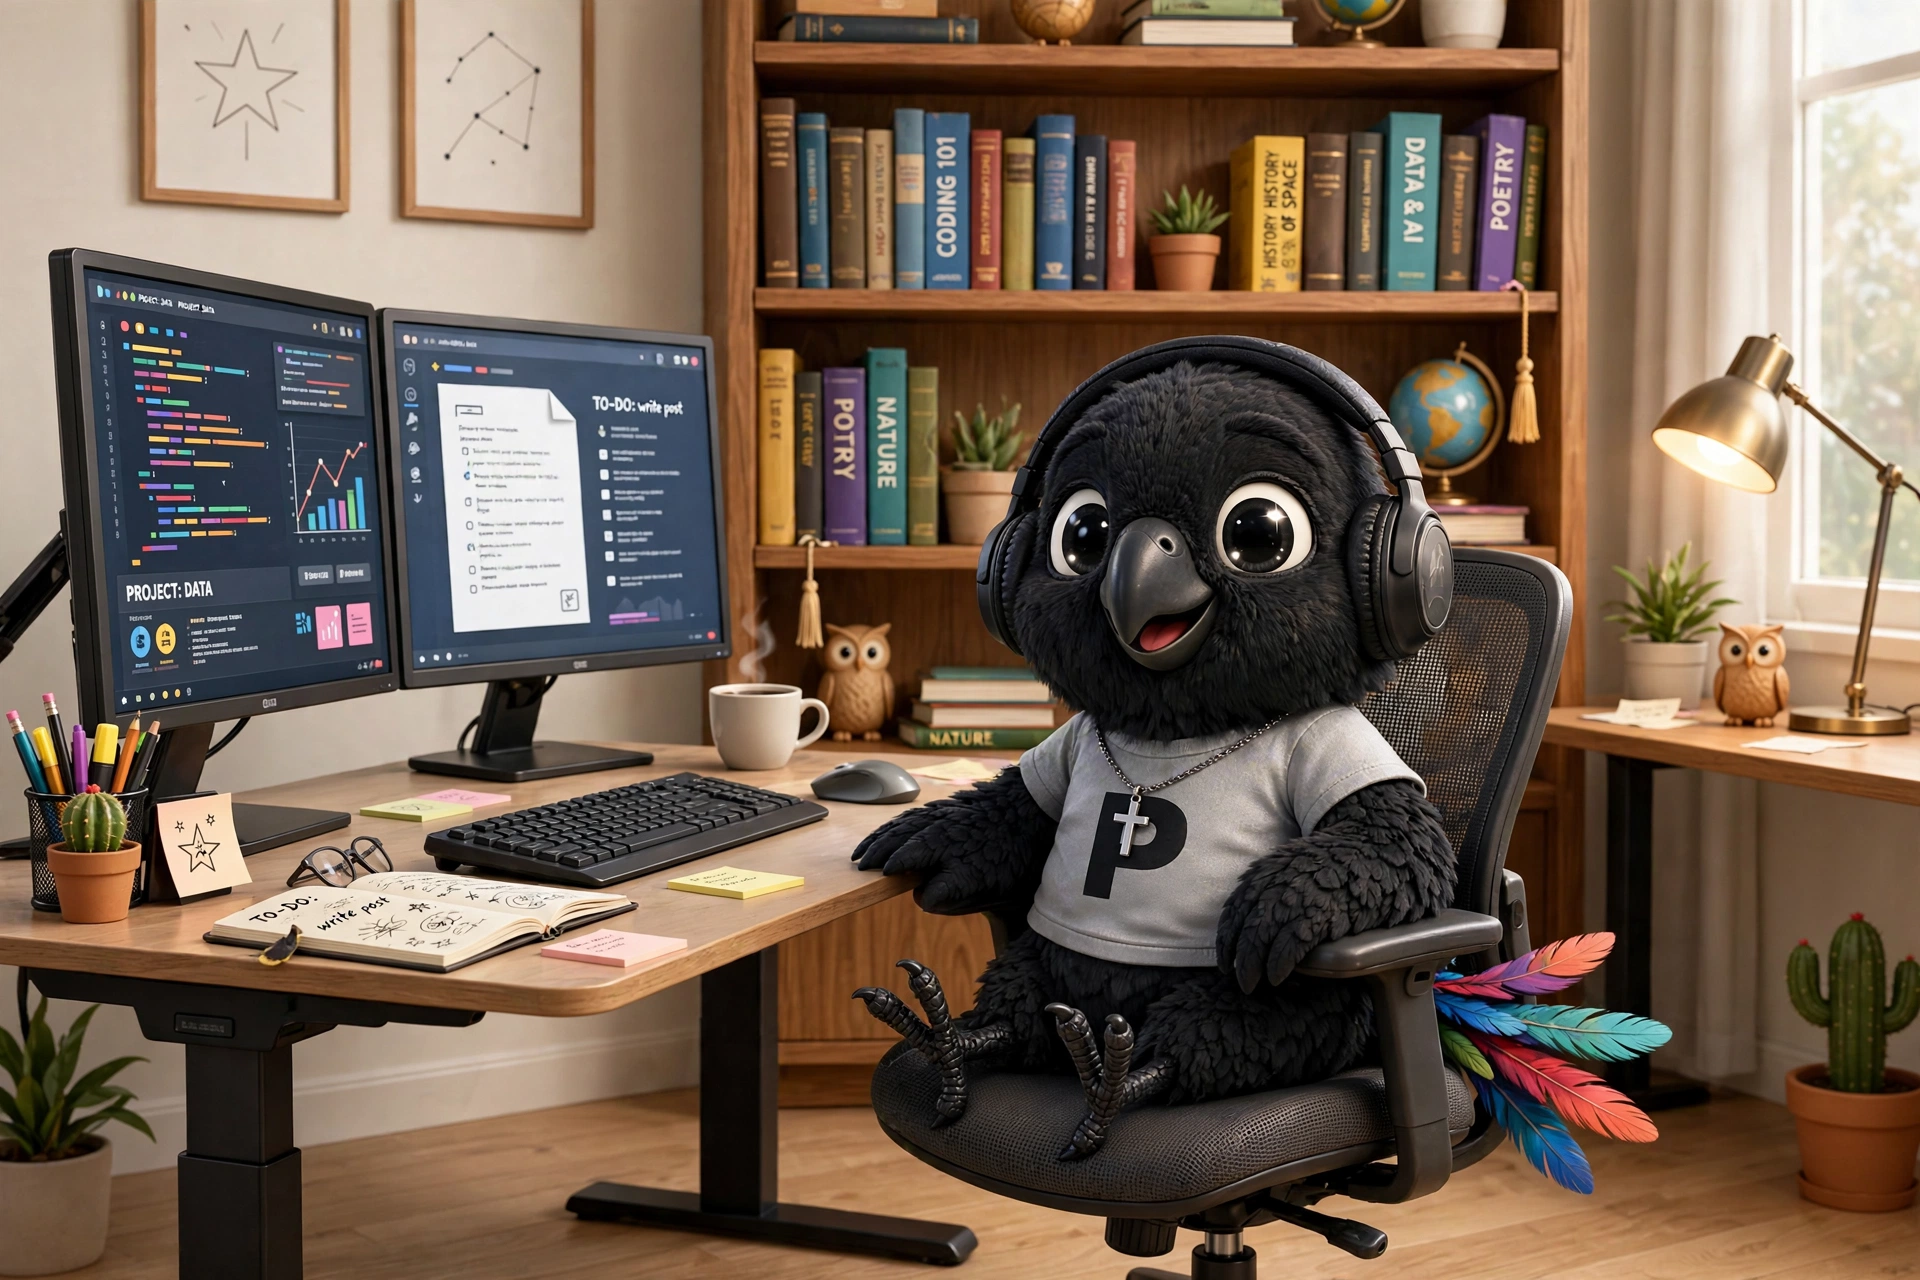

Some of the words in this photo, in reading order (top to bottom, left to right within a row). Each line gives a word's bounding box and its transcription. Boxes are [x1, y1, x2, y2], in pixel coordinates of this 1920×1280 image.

[936, 136, 957, 168] 101
[1404, 137, 1426, 193] DATA
[1264, 150, 1279, 209] HISTORY
[1282, 160, 1297, 209] SPACE
[1490, 142, 1515, 231] POETRY
[936, 175, 957, 258] CODING
[1281, 214, 1296, 232] OF
[1403, 199, 1425, 216] &
[1263, 215, 1278, 269] HISTORY
[1403, 220, 1424, 243] AI
[592, 395, 636, 412] TO-DO:
[637, 400, 662, 415] write
[664, 401, 683, 417] post
[833, 398, 855, 480] POTRY
[876, 397, 897, 489] NATURE
[126, 583, 182, 602] PROJECT:
[184, 580, 213, 598] DATA
[929, 731, 994, 746] NATURE
[1083, 791, 1187, 900] P
[249, 896, 318, 922] TO-DO:
[316, 909, 357, 931] write
[361, 896, 390, 915] post
